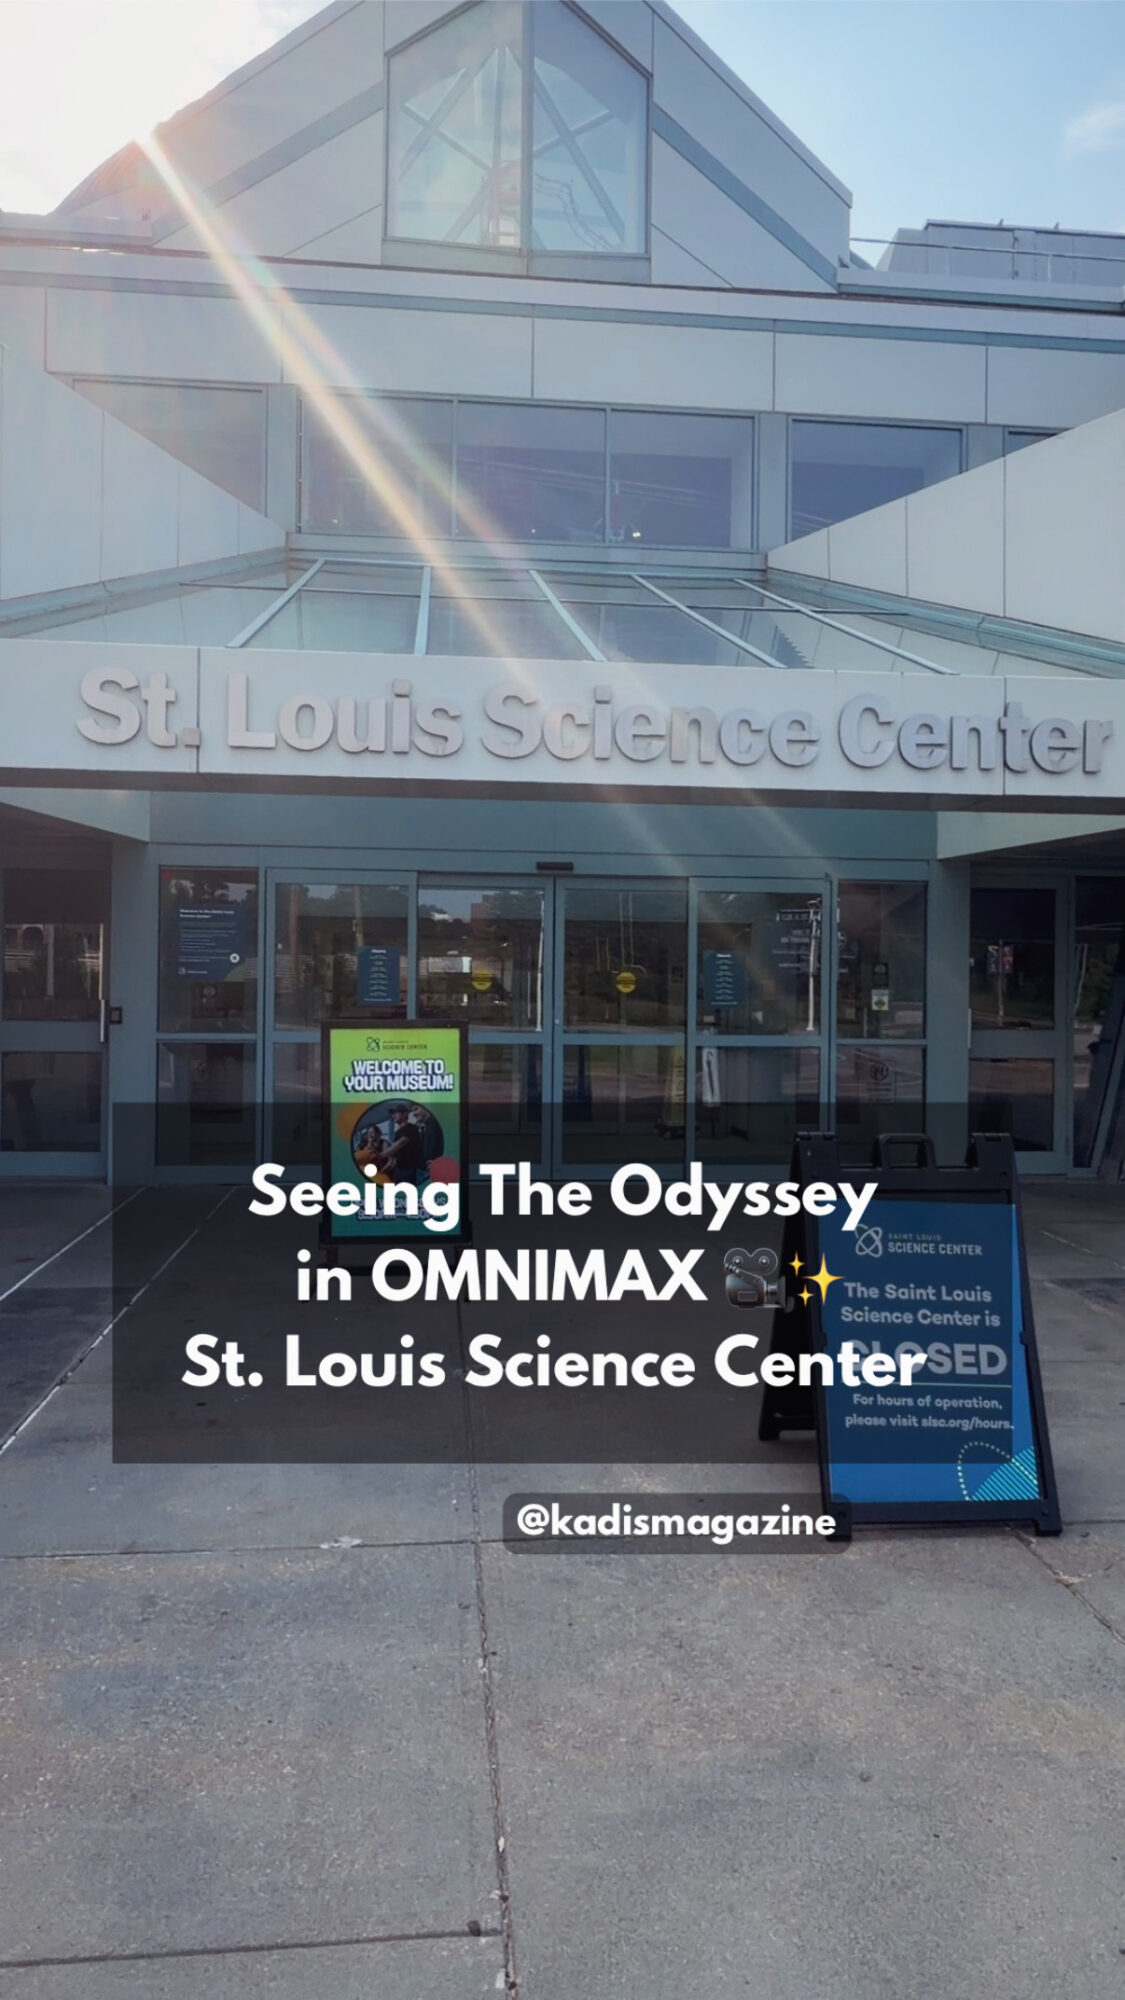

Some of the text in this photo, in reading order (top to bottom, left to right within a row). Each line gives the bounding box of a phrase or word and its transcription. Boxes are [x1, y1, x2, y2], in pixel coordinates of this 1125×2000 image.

[76, 666, 1114, 775] St. Louis Science Center
[353, 1059, 445, 1075] WELCOME TO
[344, 1074, 454, 1091] YOUR MUSEUM!
[888, 1233, 941, 1241] SAINT LOUIS
[888, 1242, 983, 1256] SCIENCE CENTER
[843, 1282, 992, 1302] The Saint Louis
[840, 1306, 1001, 1327] Science Center is
[853, 1393, 1003, 1410] For hours of operation,
[845, 1414, 1015, 1431] please visit slsc.org/hours.
